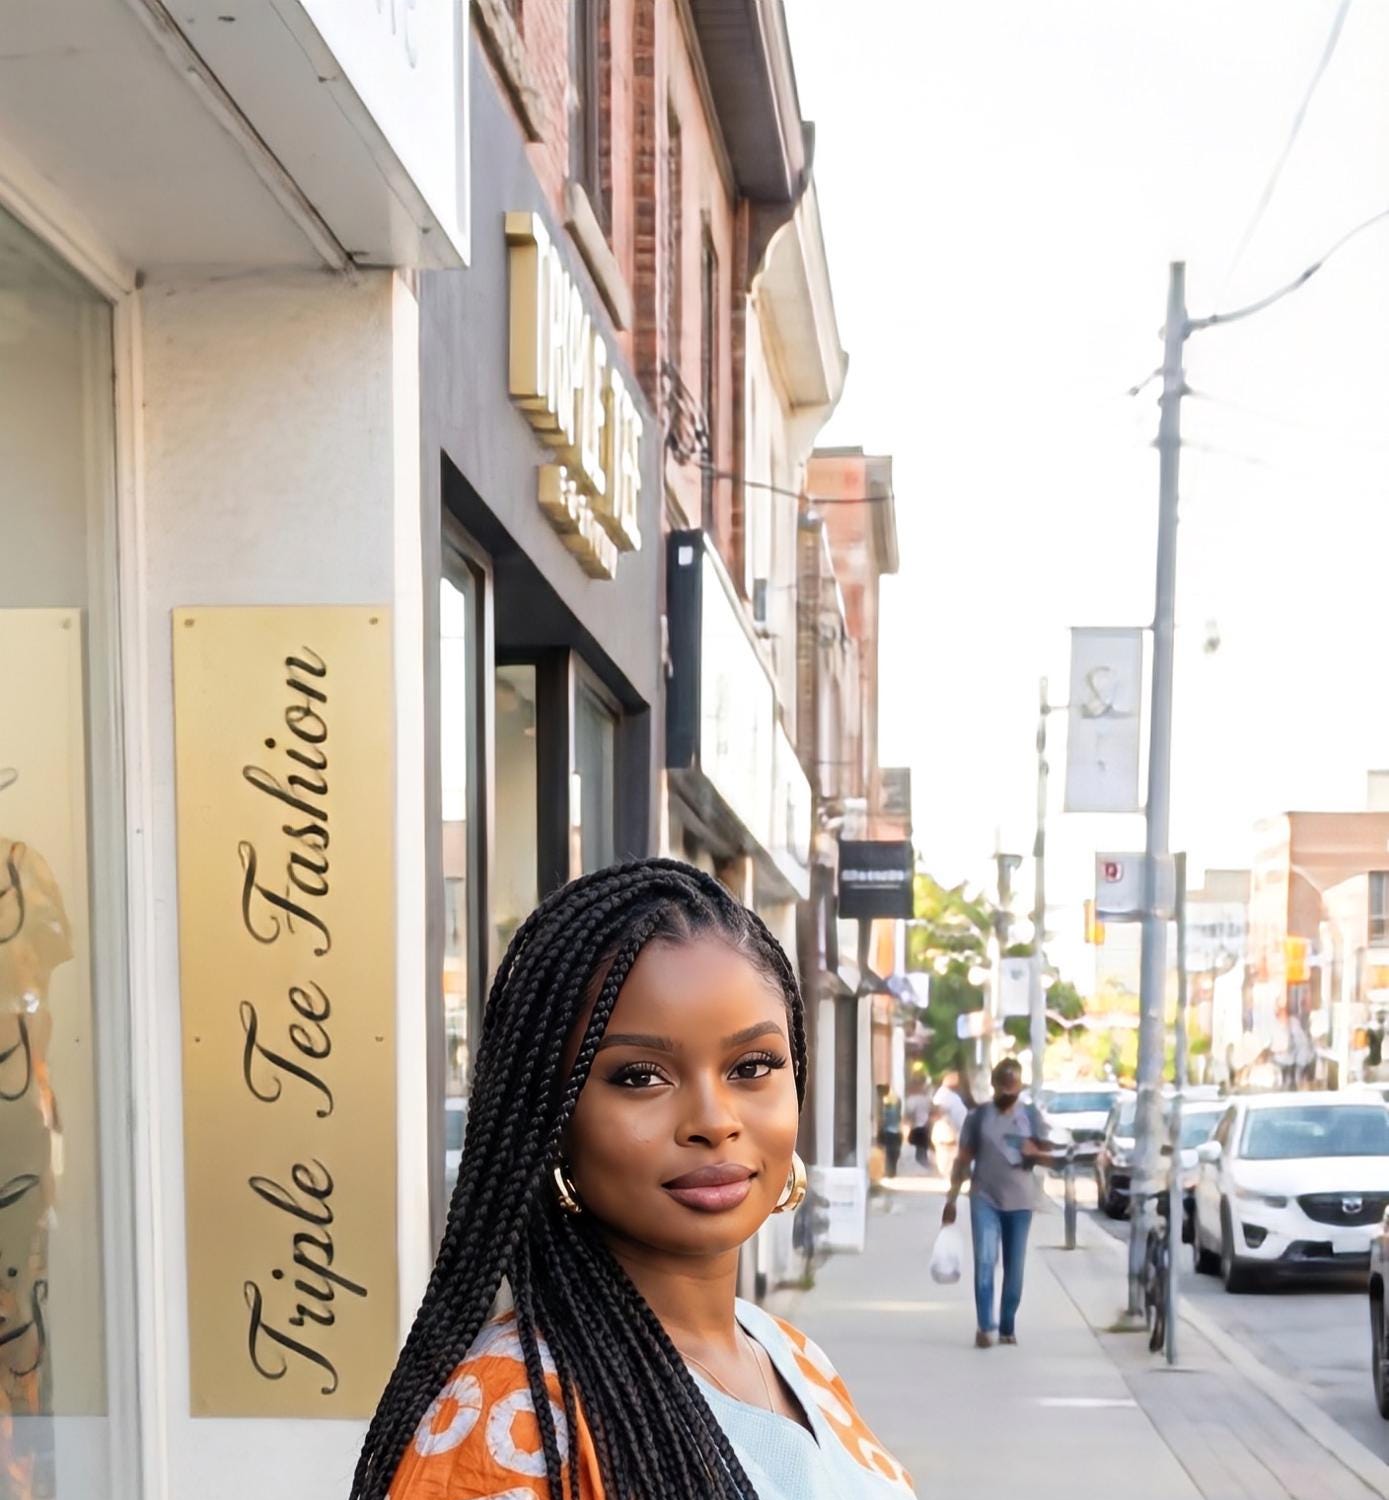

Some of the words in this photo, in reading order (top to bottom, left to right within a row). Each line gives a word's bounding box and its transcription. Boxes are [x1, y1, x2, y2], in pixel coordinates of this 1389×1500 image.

[238, 646, 332, 957] Fashion
[239, 980, 334, 1119] Tee
[244, 1158, 368, 1396] Triple
